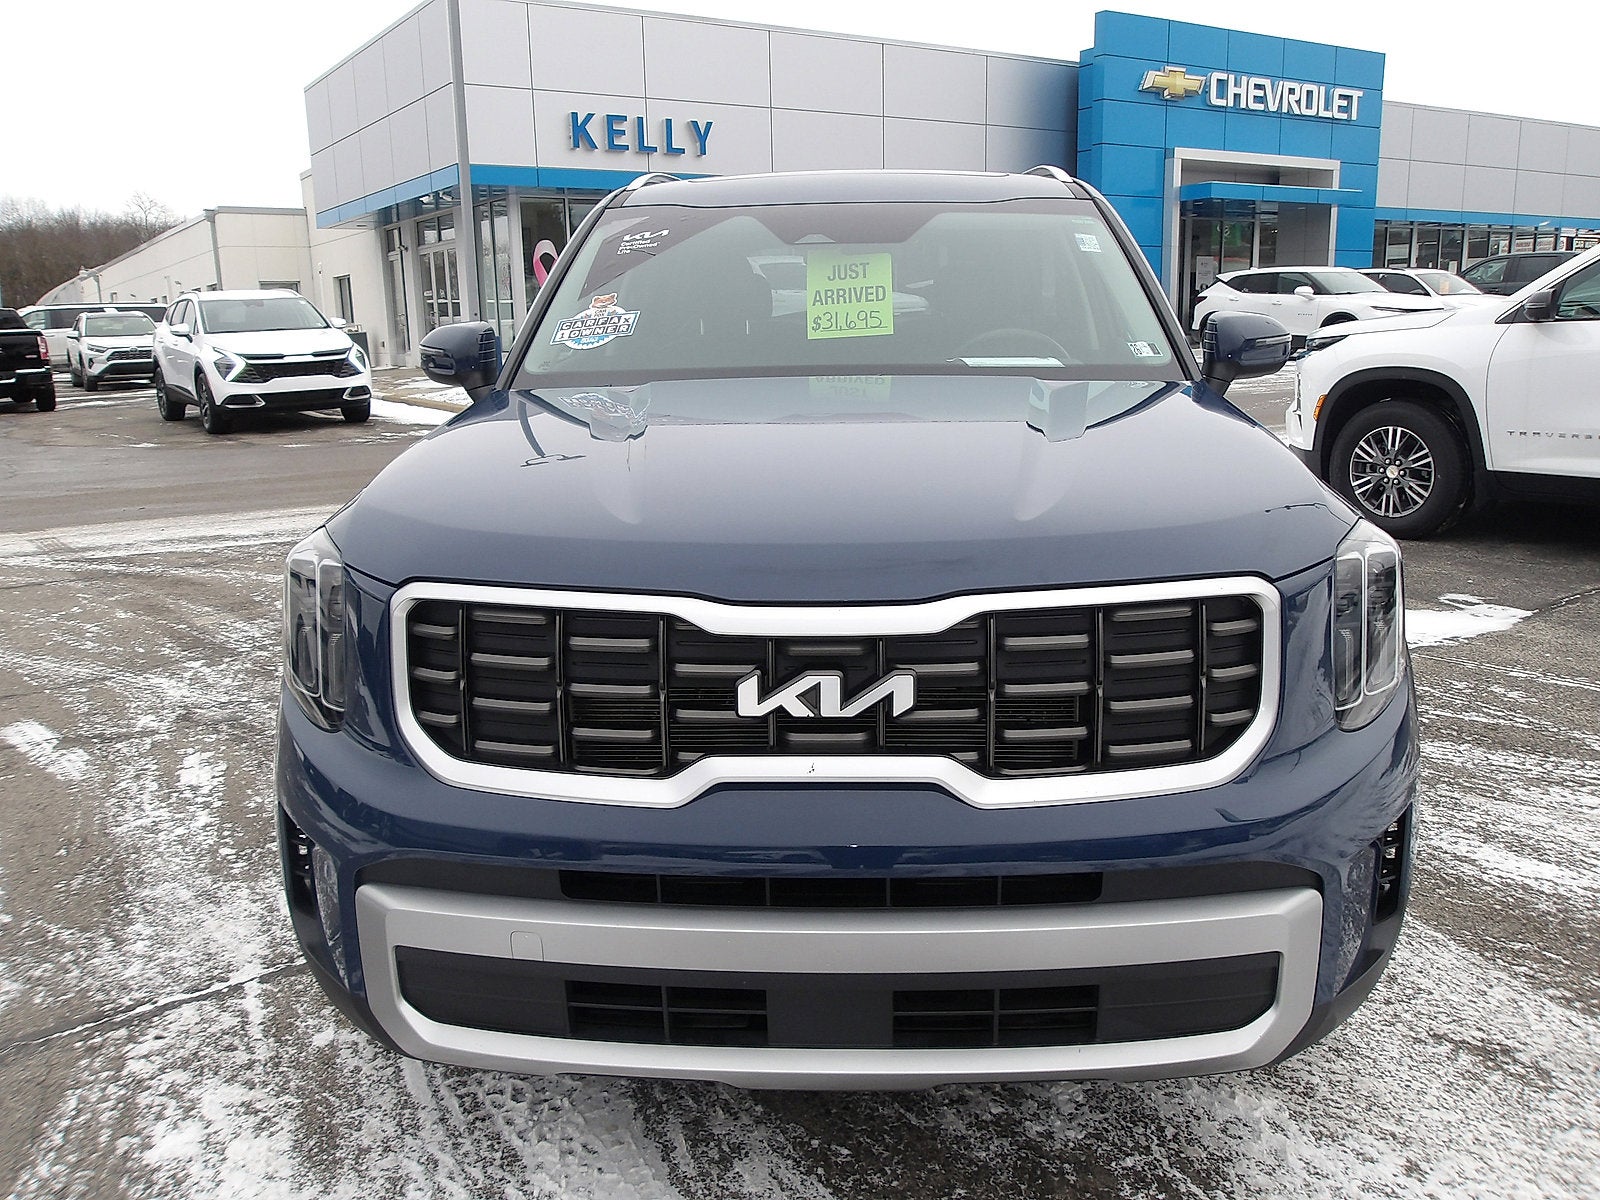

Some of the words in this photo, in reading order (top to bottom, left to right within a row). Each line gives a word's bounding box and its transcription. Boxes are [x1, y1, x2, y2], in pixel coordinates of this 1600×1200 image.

[1208, 71, 1363, 121] CHEVROLET
[569, 111, 713, 156] KELLY
[827, 262, 870, 282] JUST
[811, 285, 887, 307] ARRIVED
[560, 315, 631, 330] CARFAX
[568, 323, 630, 339] OWNER
[811, 310, 884, 333] $31,695
[735, 669, 916, 718] KIA
